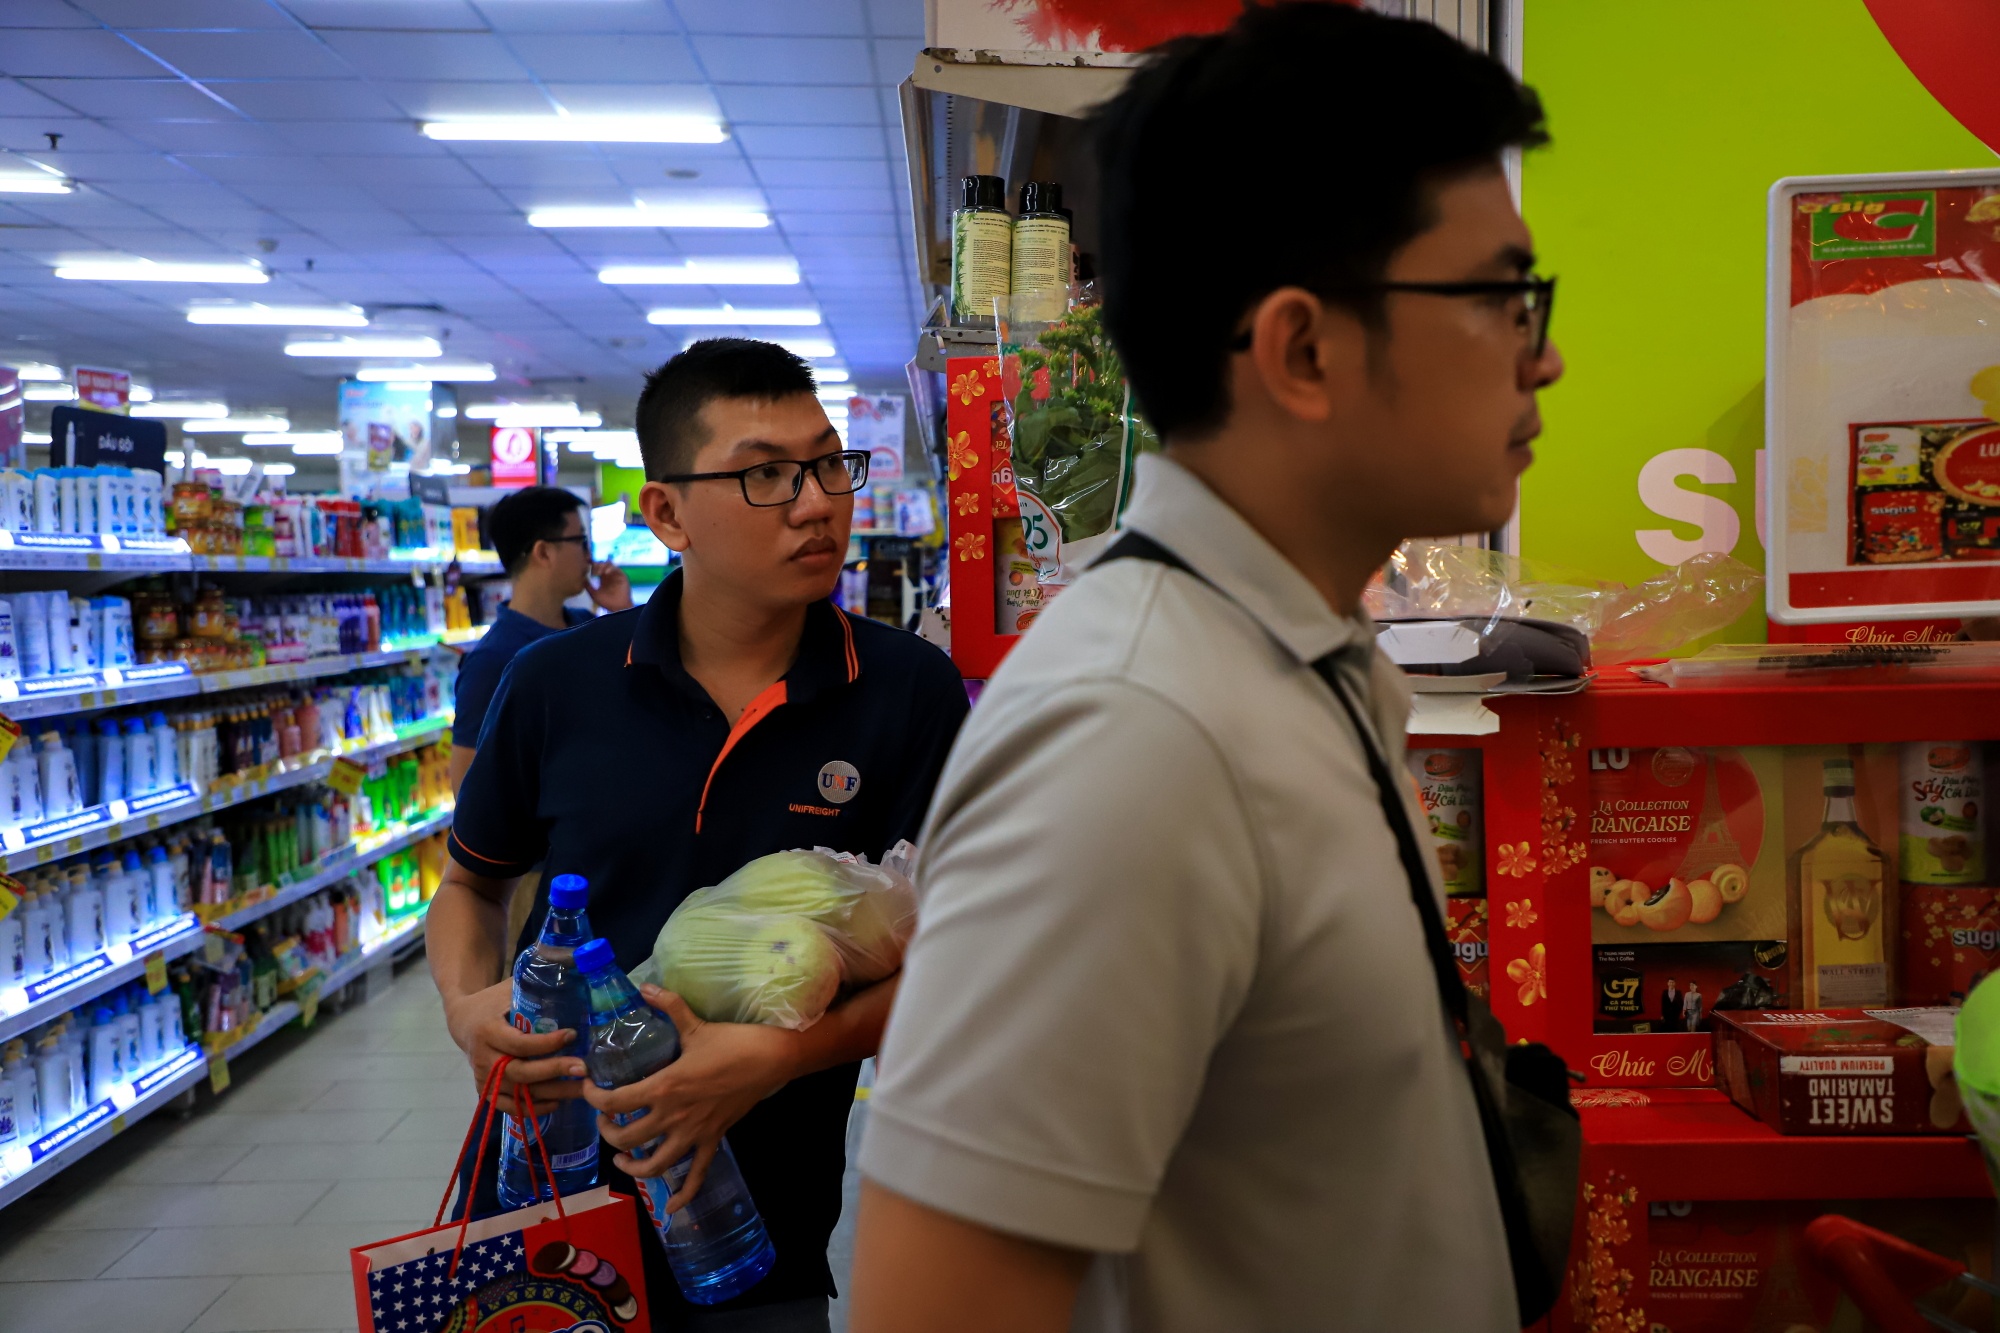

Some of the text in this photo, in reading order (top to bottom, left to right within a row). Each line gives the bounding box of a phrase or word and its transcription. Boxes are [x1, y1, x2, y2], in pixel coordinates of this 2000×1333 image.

[1829, 201, 1886, 214] Big
[822, 773, 857, 791] UNF
[1420, 785, 1441, 810] ấy
[788, 803, 841, 817] UNIFREIGHT
[1590, 815, 1691, 834] RANÇAISE
[1647, 836, 1677, 844] COOKIES
[1848, 967, 1882, 975] STREET
[1590, 1050, 1656, 1078] Chúc
[1799, 1060, 1886, 1071] PREMIUM QUALITY
[1808, 1078, 1896, 1097] TAMARIND
[1809, 1097, 1894, 1125] SWEET
